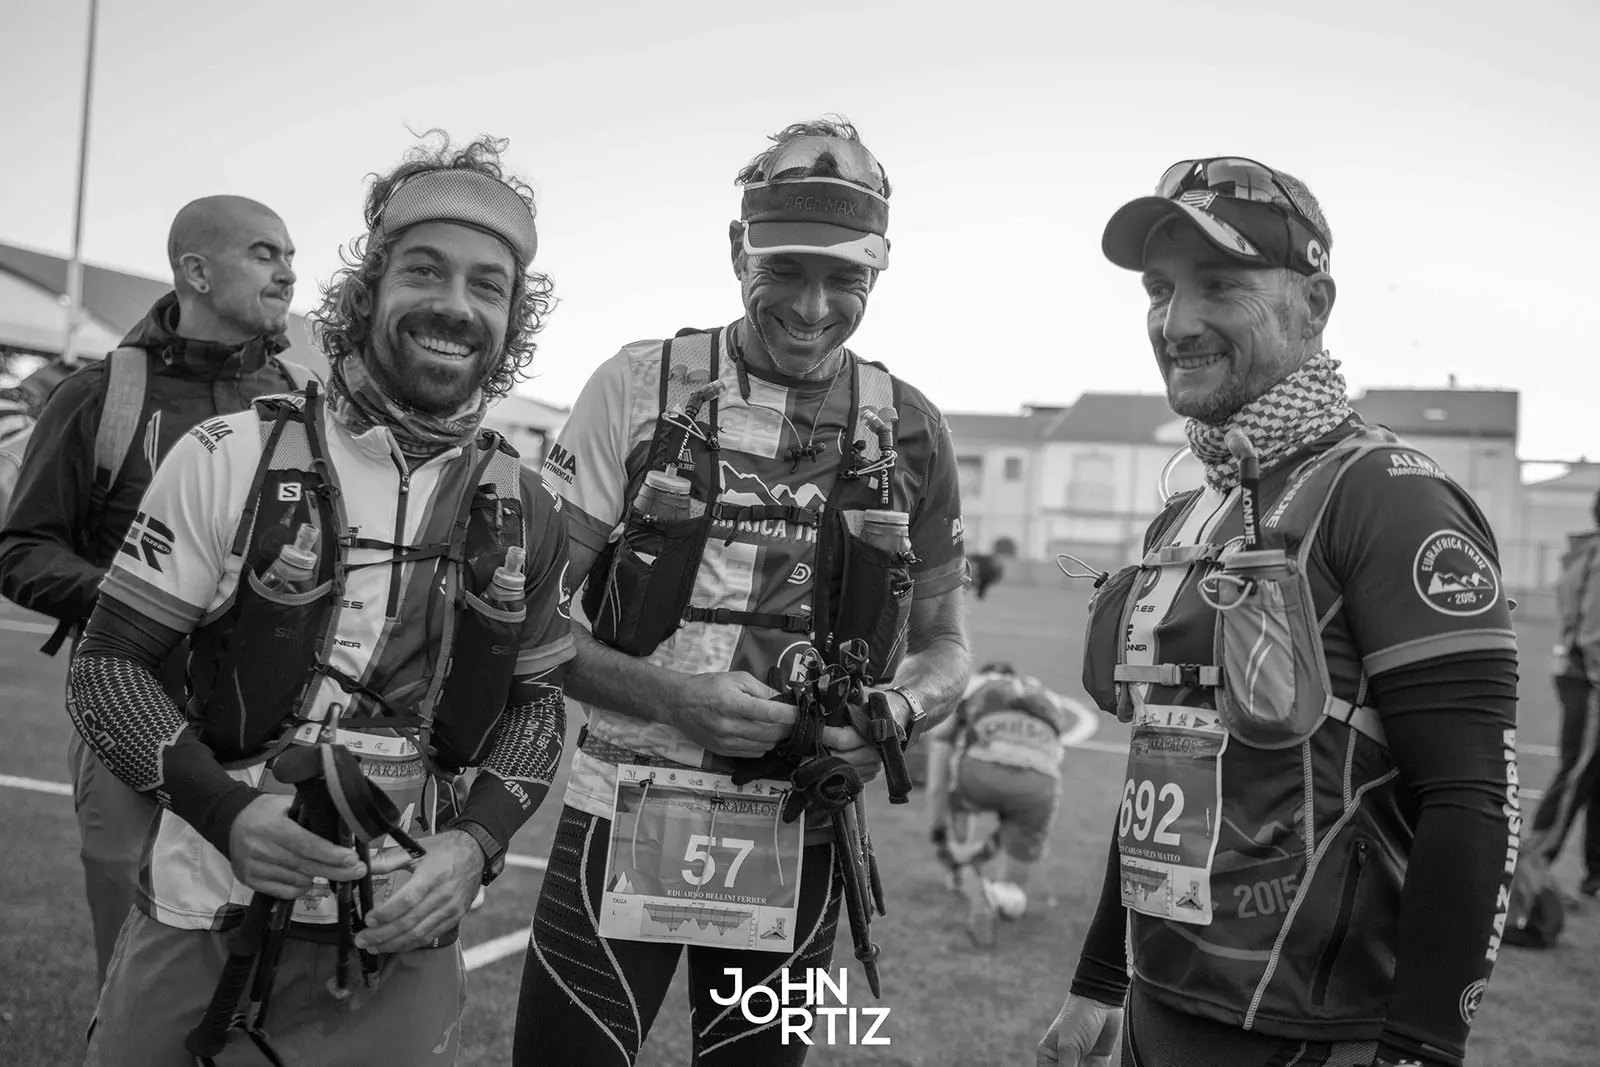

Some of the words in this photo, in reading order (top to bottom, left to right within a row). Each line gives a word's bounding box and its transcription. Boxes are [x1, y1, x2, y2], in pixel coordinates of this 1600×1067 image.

[1241, 486, 1257, 546] AONIJIE
[1421, 536, 1463, 573] EURAFRICA
[1454, 592, 1477, 605] 2015
[1118, 778, 1185, 846] 692
[681, 834, 755, 889] 57
[1157, 851, 1181, 863] MATEO
[705, 892, 736, 902] BELLINI
[737, 895, 768, 905] FERRER
[1233, 874, 1299, 919] 2015
